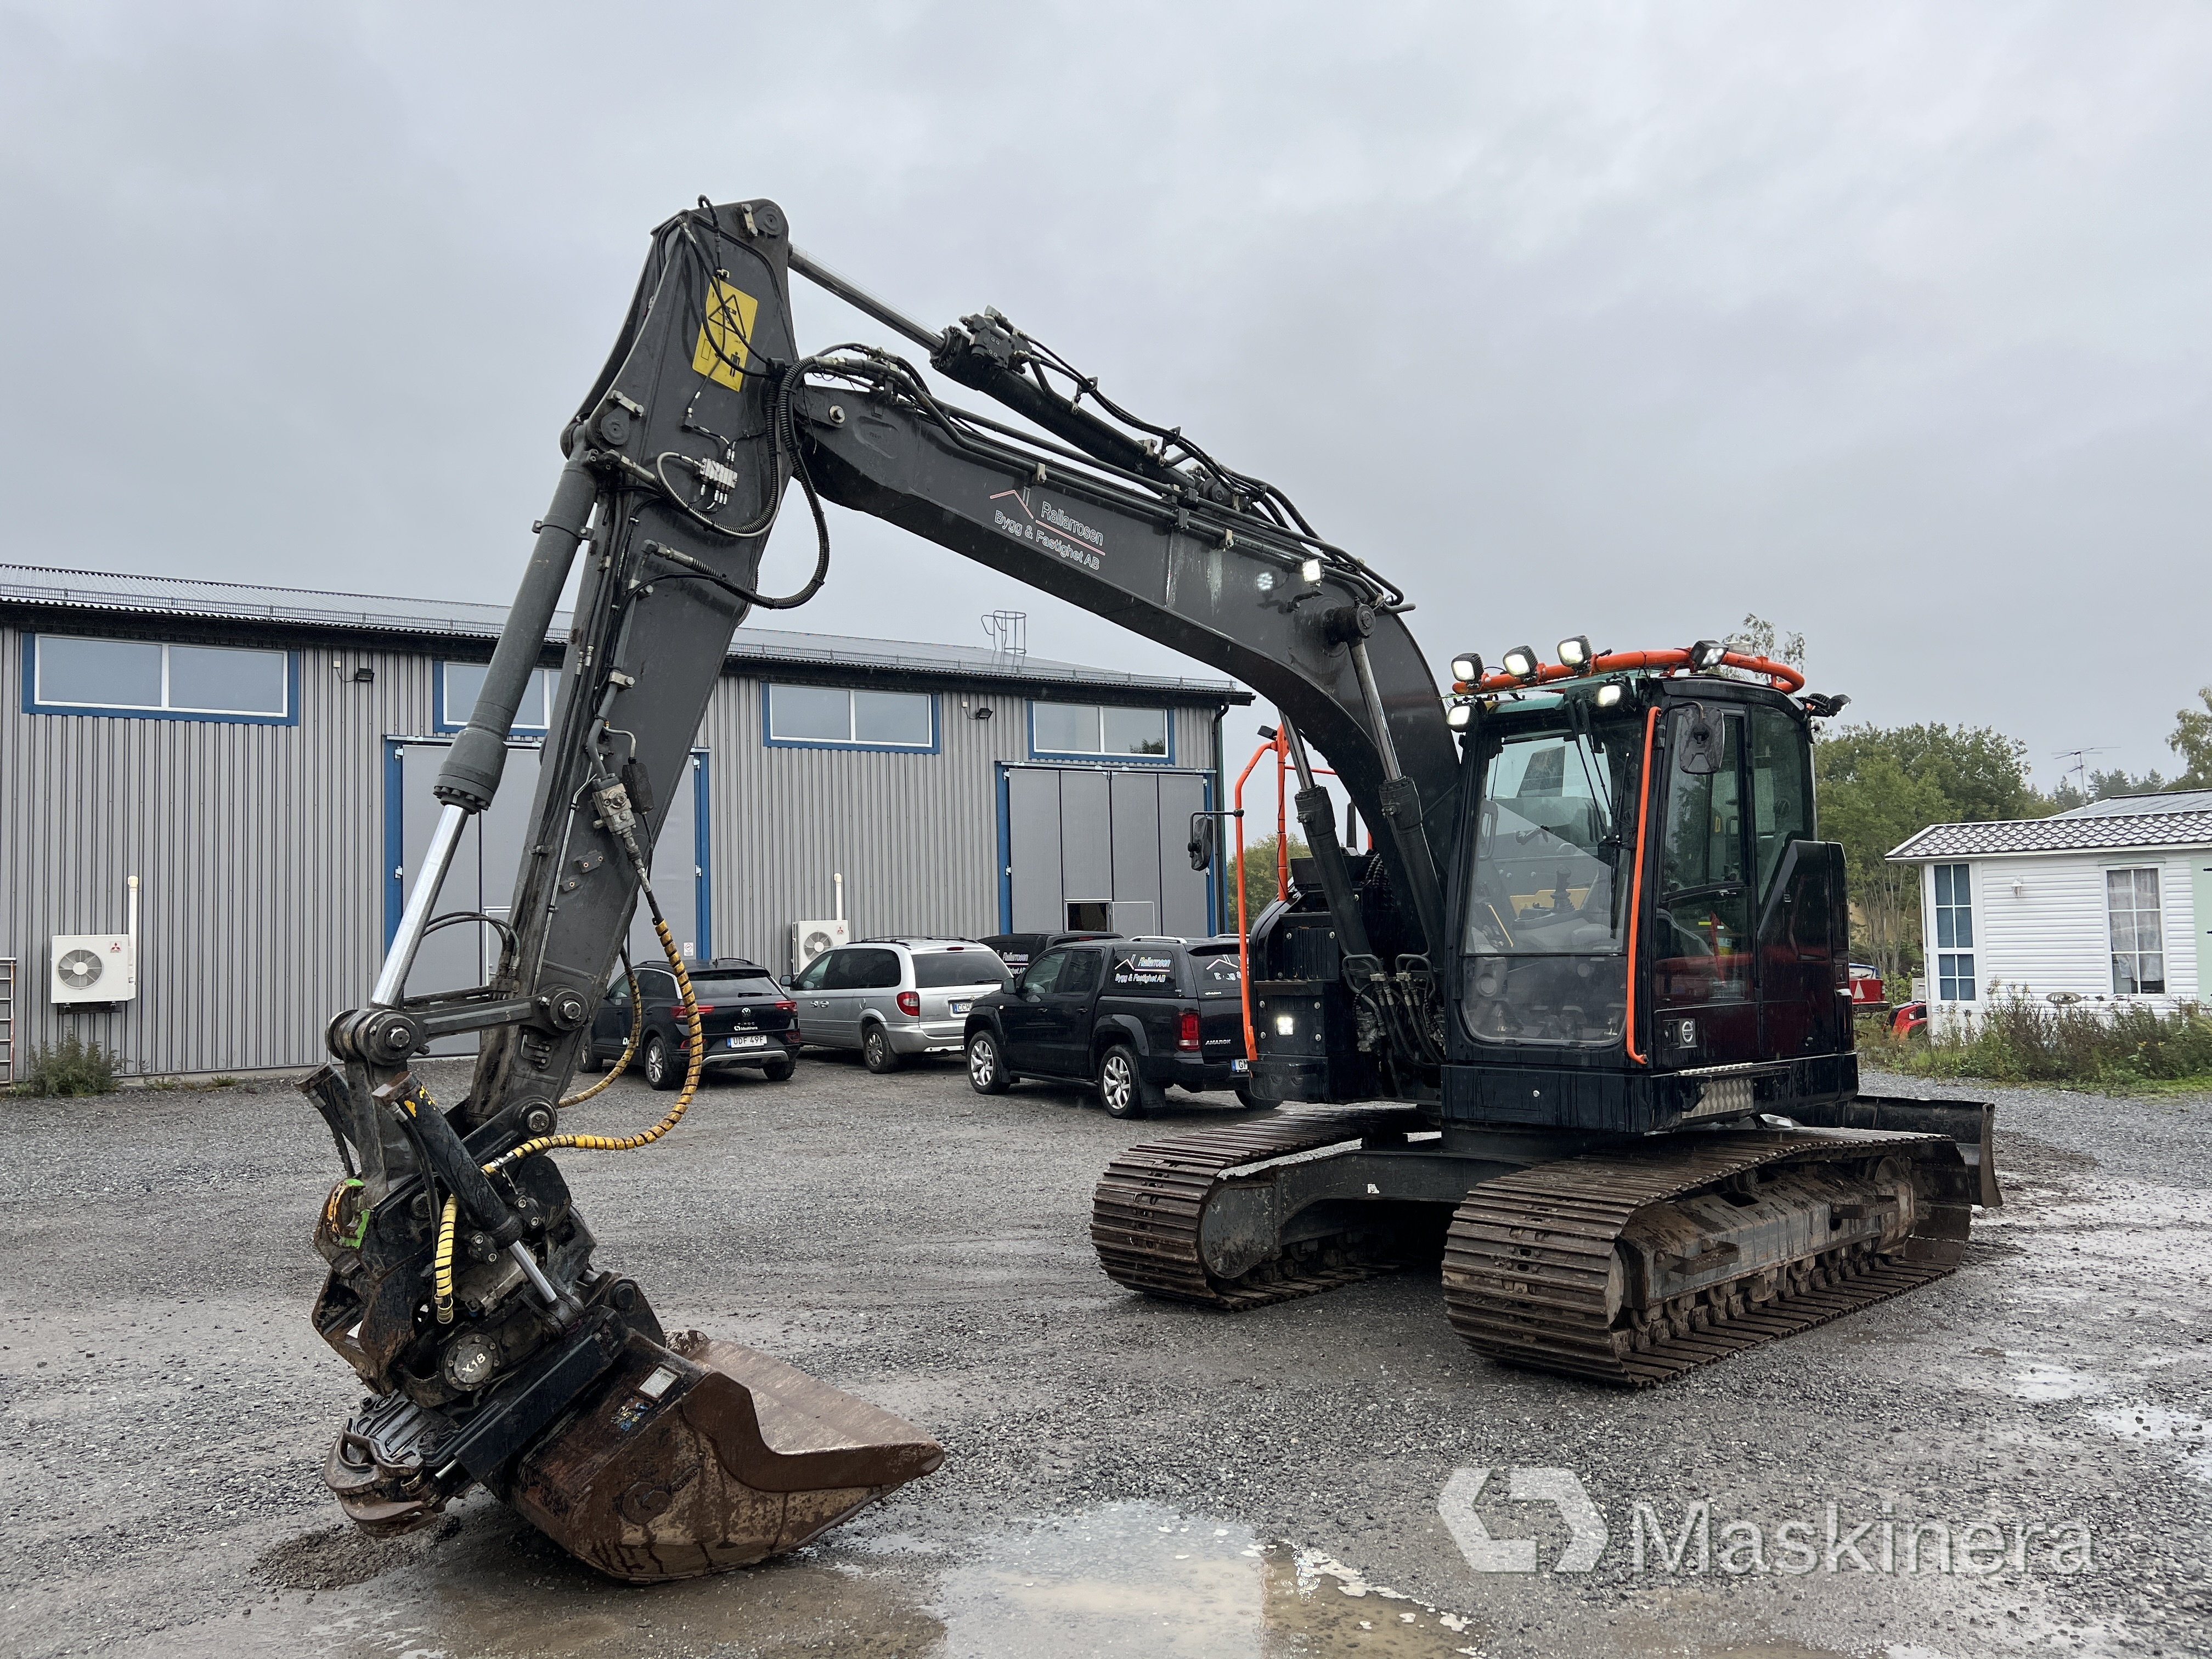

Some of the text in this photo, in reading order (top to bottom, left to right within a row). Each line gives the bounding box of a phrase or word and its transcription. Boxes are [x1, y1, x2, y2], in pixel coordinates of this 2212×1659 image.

[995, 510, 1100, 571] Bygg & Fastighet AB
[1041, 501, 1104, 546] Rallarrosen
[733, 1036, 747, 1045] UDF
